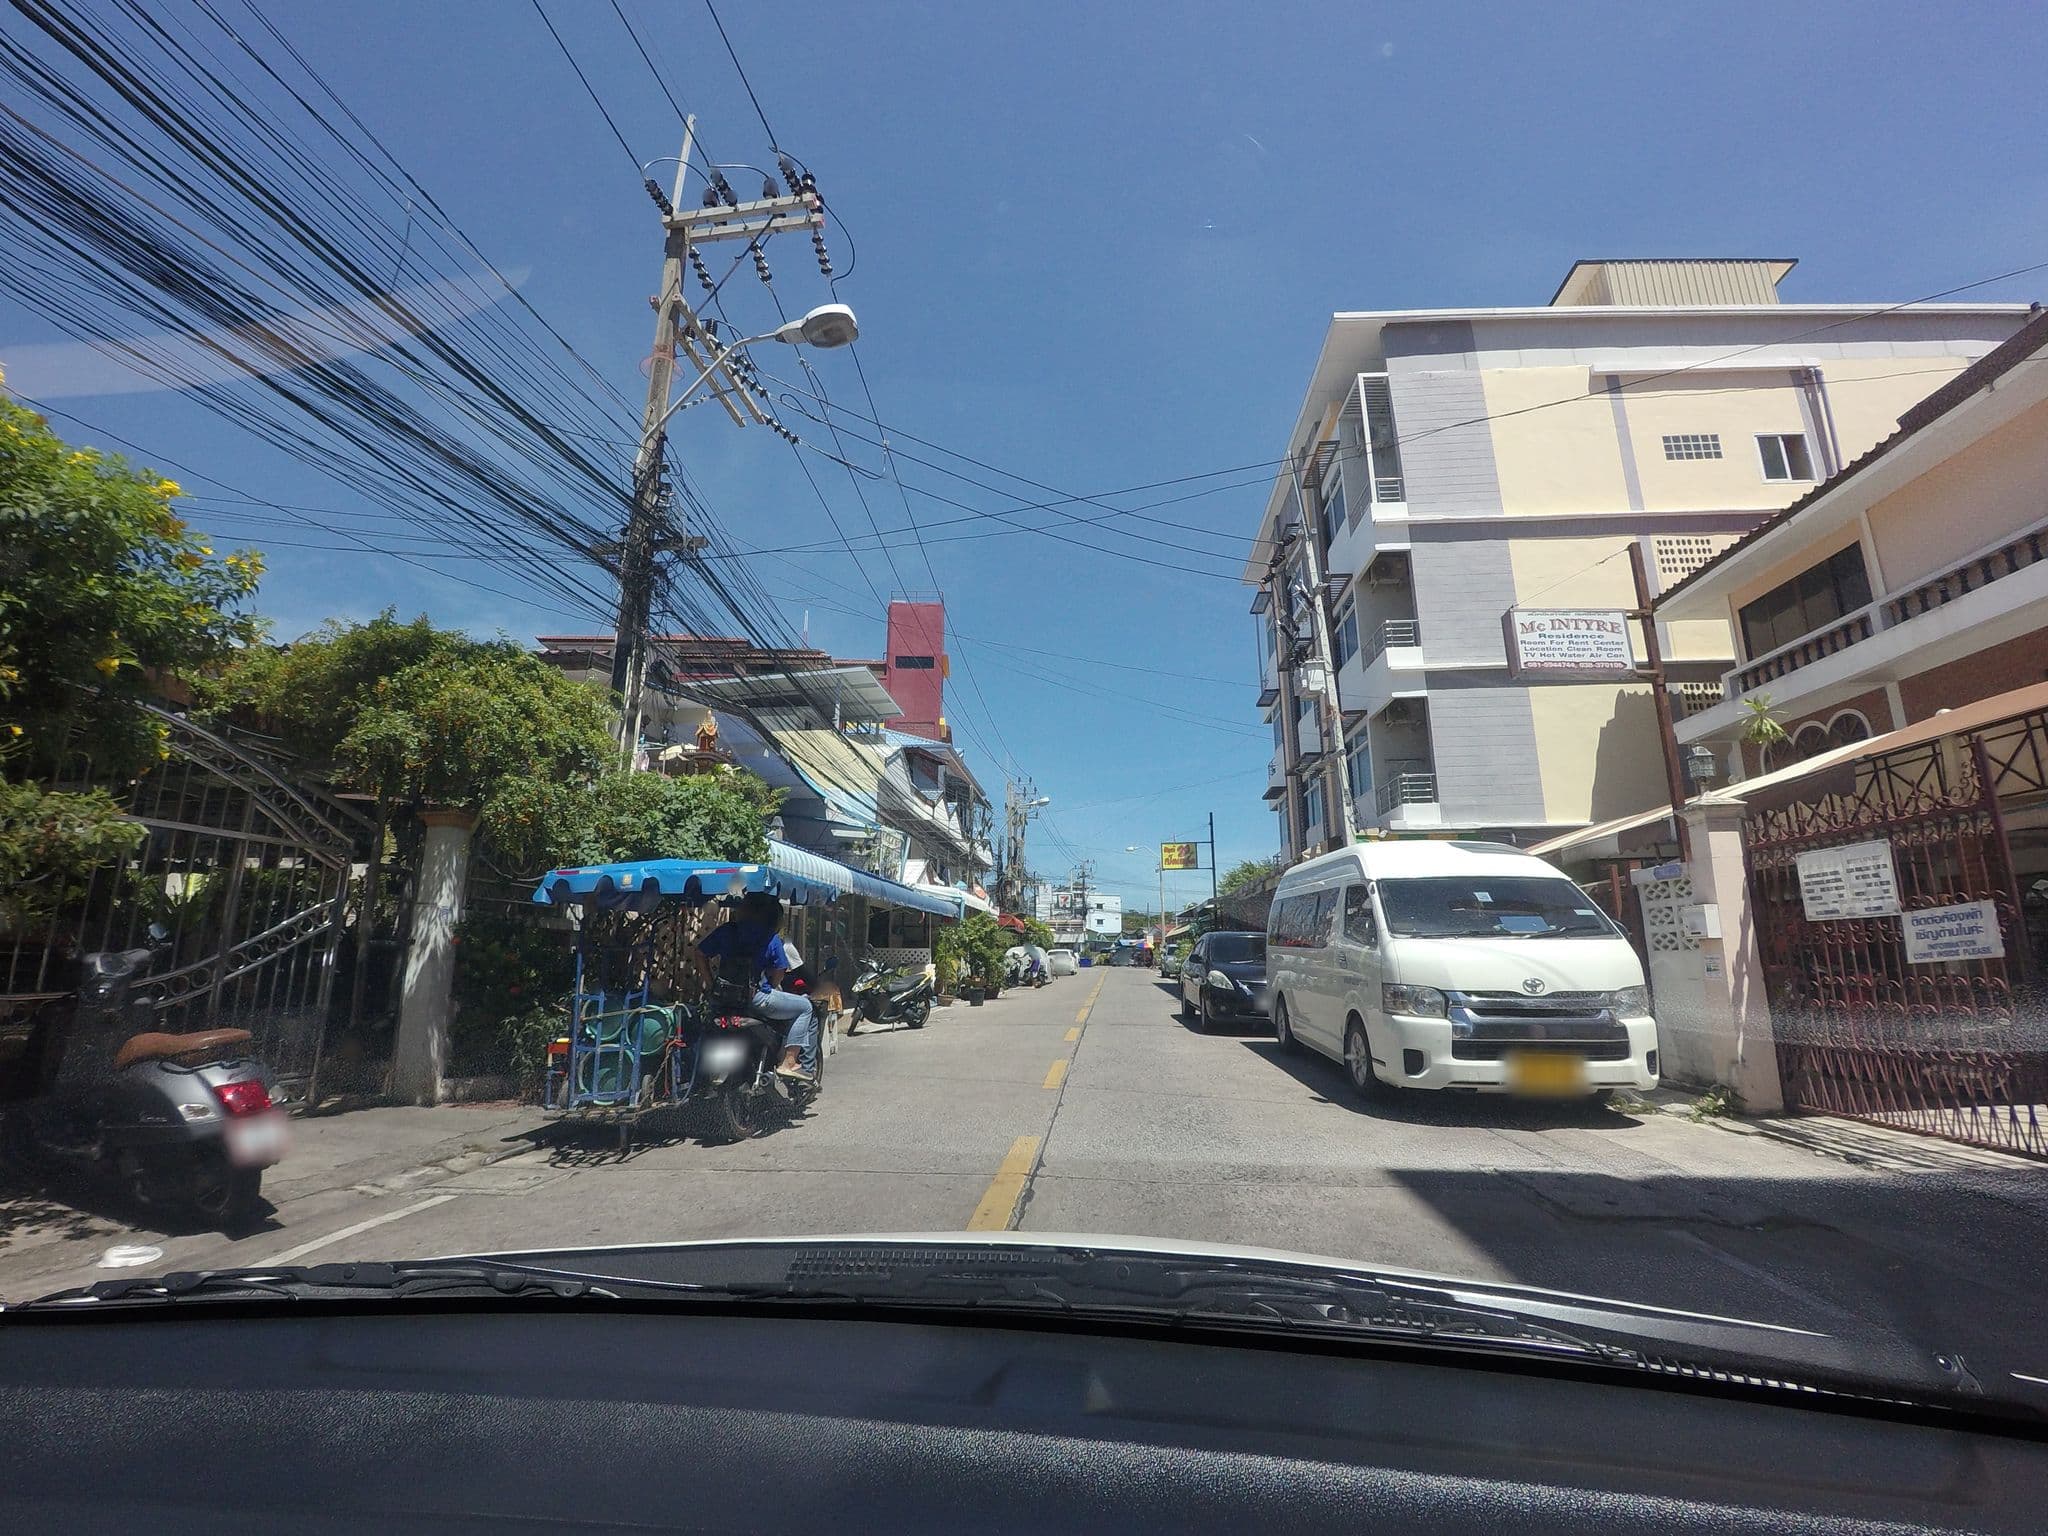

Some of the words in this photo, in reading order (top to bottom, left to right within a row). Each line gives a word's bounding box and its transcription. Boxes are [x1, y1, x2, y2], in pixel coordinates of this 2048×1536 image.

[1520, 620, 1546, 634] Mc
[1549, 618, 1623, 634] INTYRE
[1927, 940, 1977, 950] INFORMATION
[1914, 951, 1934, 960] COME
[1936, 949, 1960, 958] INSIDE
[1963, 946, 1993, 955] PLEASE
